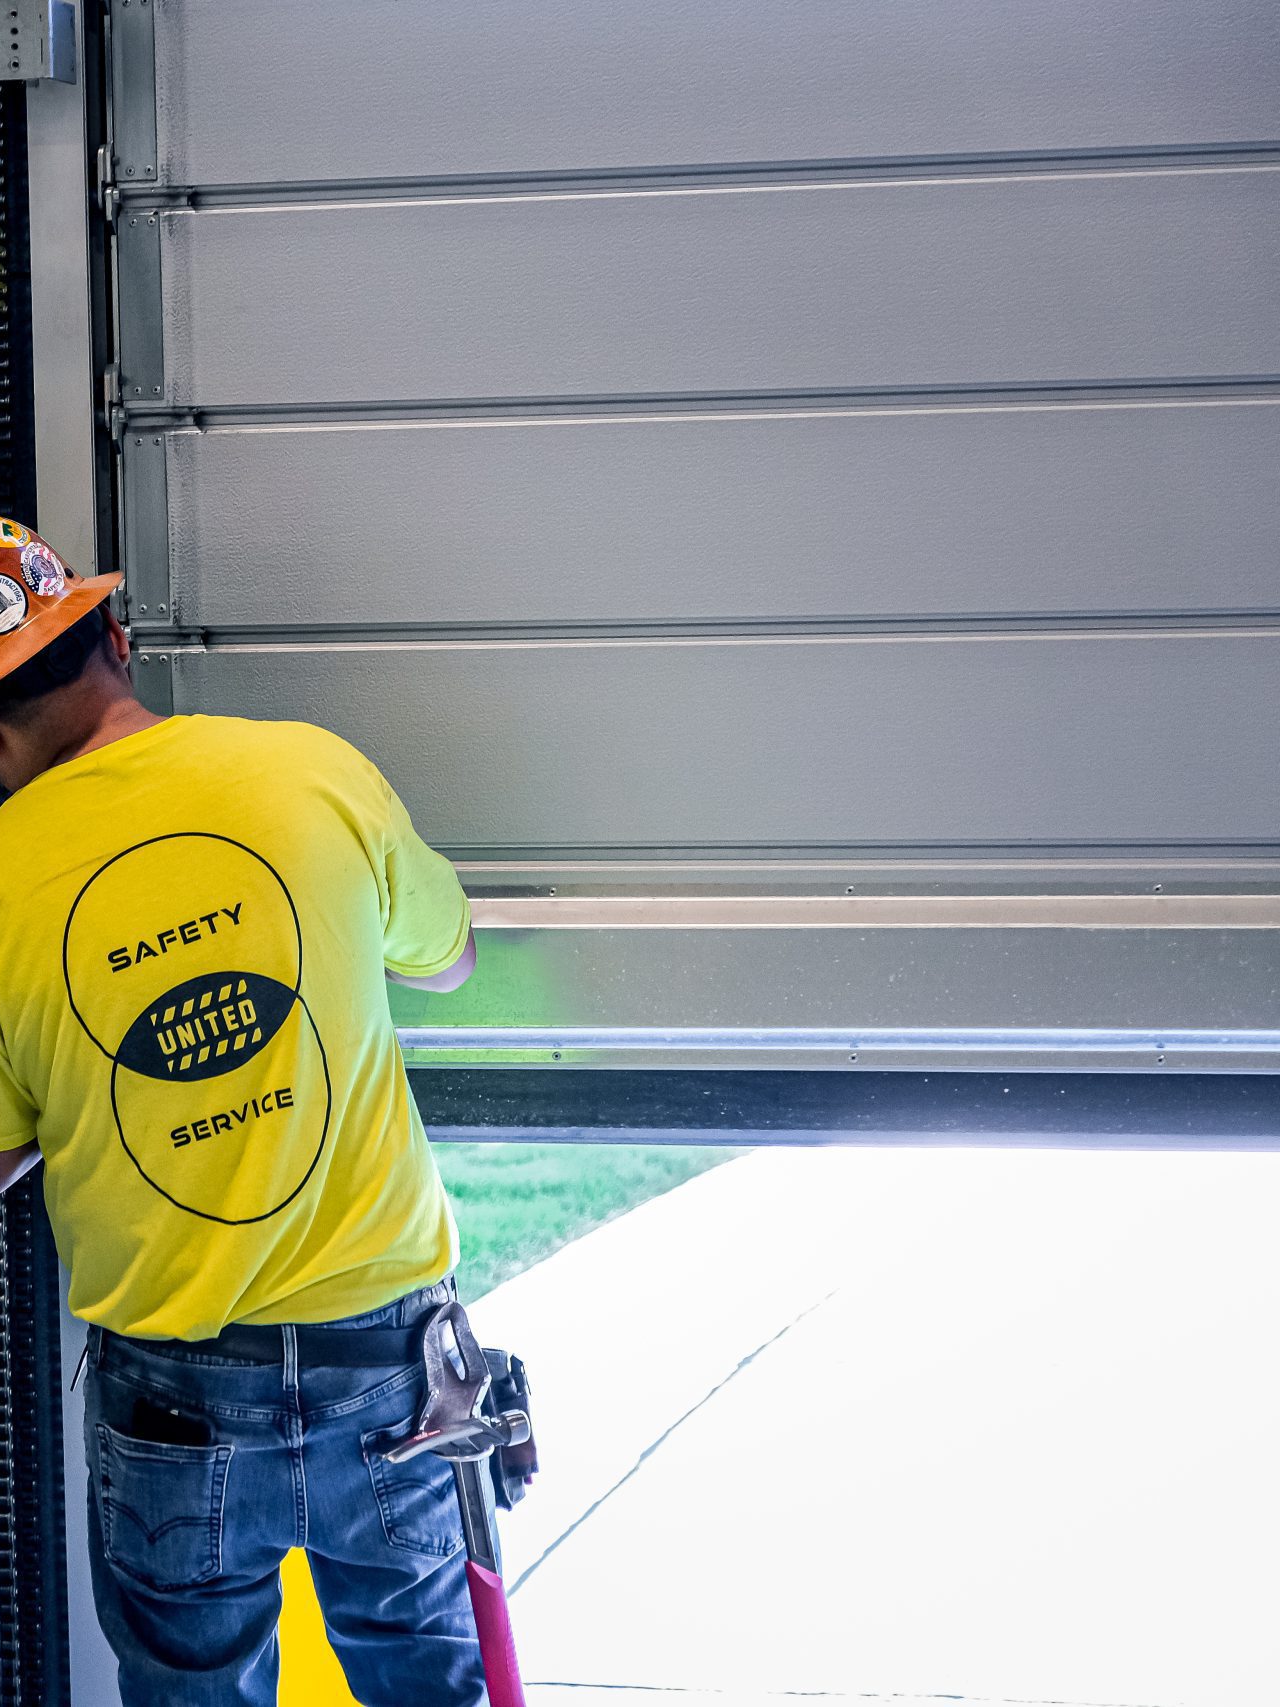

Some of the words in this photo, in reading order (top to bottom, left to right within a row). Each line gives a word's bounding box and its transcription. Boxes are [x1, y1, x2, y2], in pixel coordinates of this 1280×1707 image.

[107, 902, 243, 974] SAFETY
[157, 999, 258, 1056] UNITED
[170, 1087, 294, 1149] SERVICE
